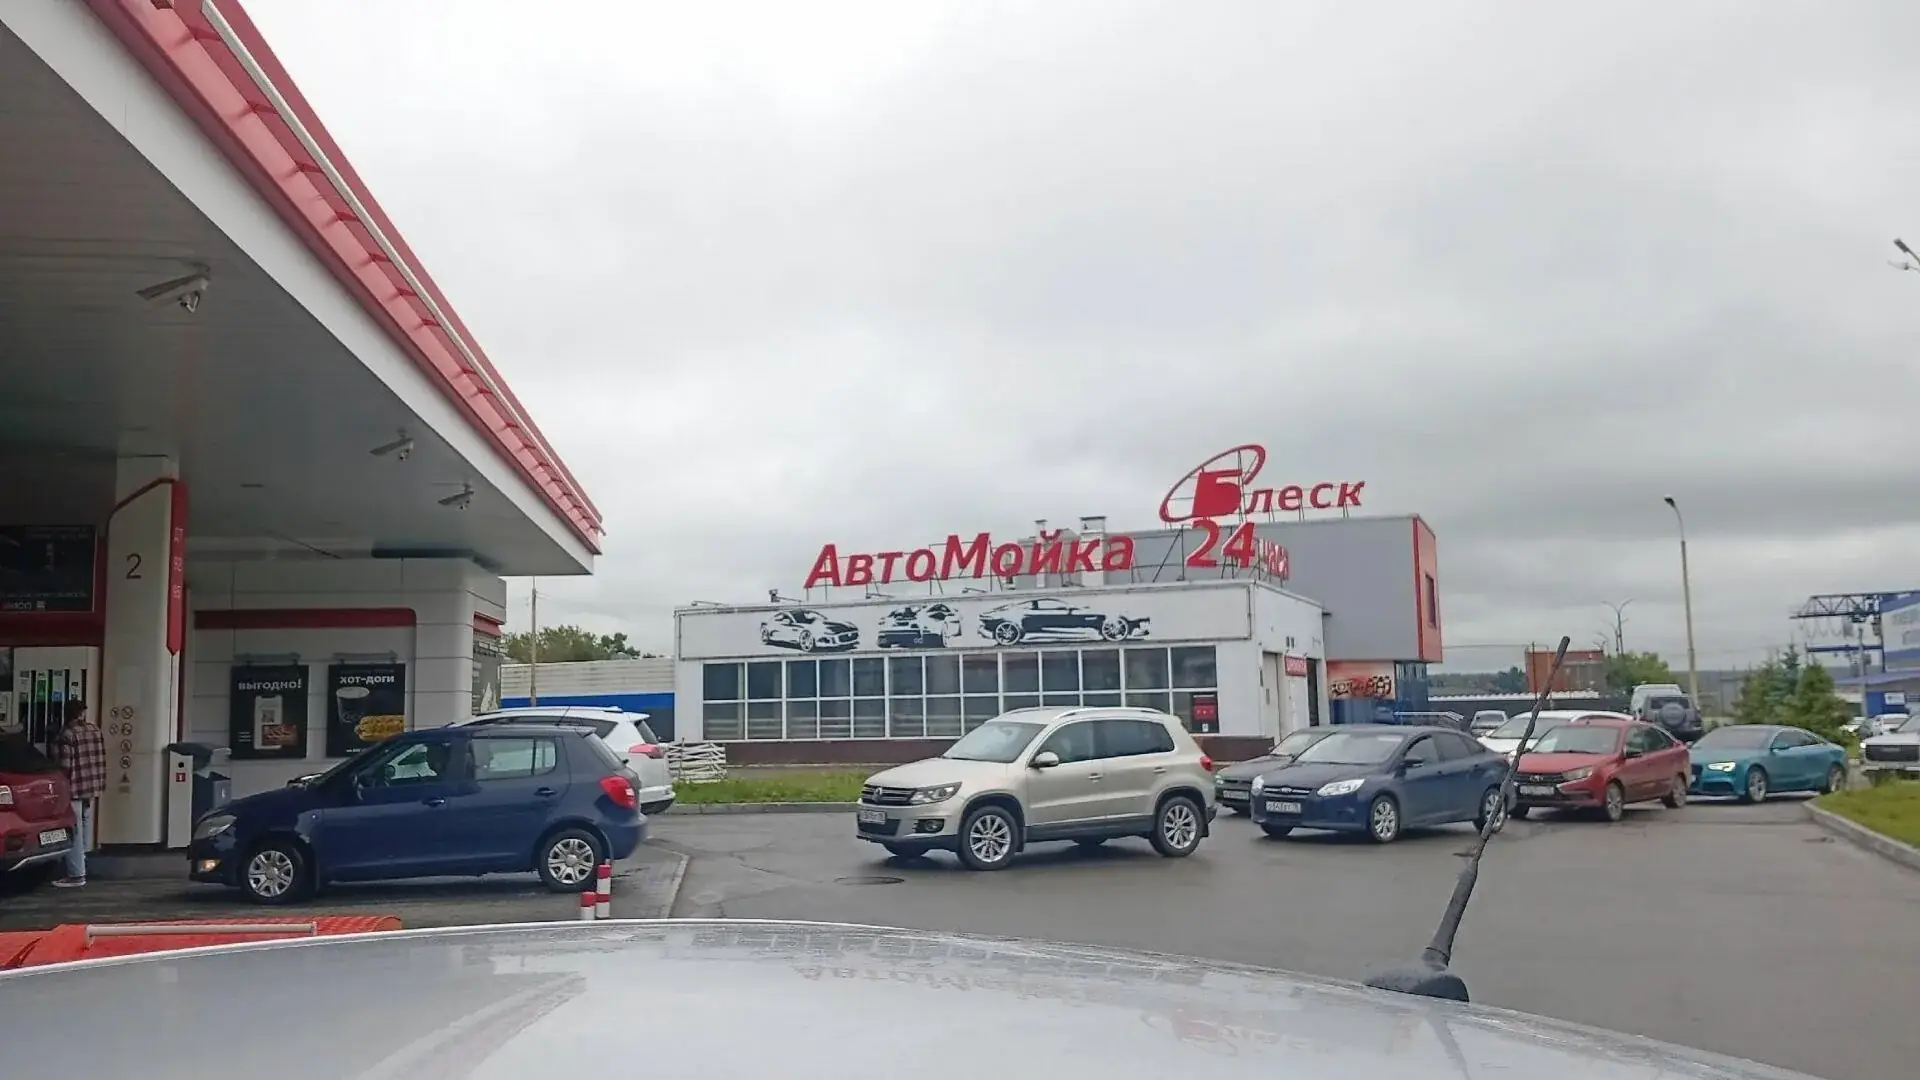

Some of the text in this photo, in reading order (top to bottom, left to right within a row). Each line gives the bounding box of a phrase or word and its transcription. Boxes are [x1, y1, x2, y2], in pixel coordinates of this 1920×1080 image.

[126, 553, 142, 579] 2
[804, 529, 1135, 588] АвтоМойка
[1186, 518, 1256, 568] 24
